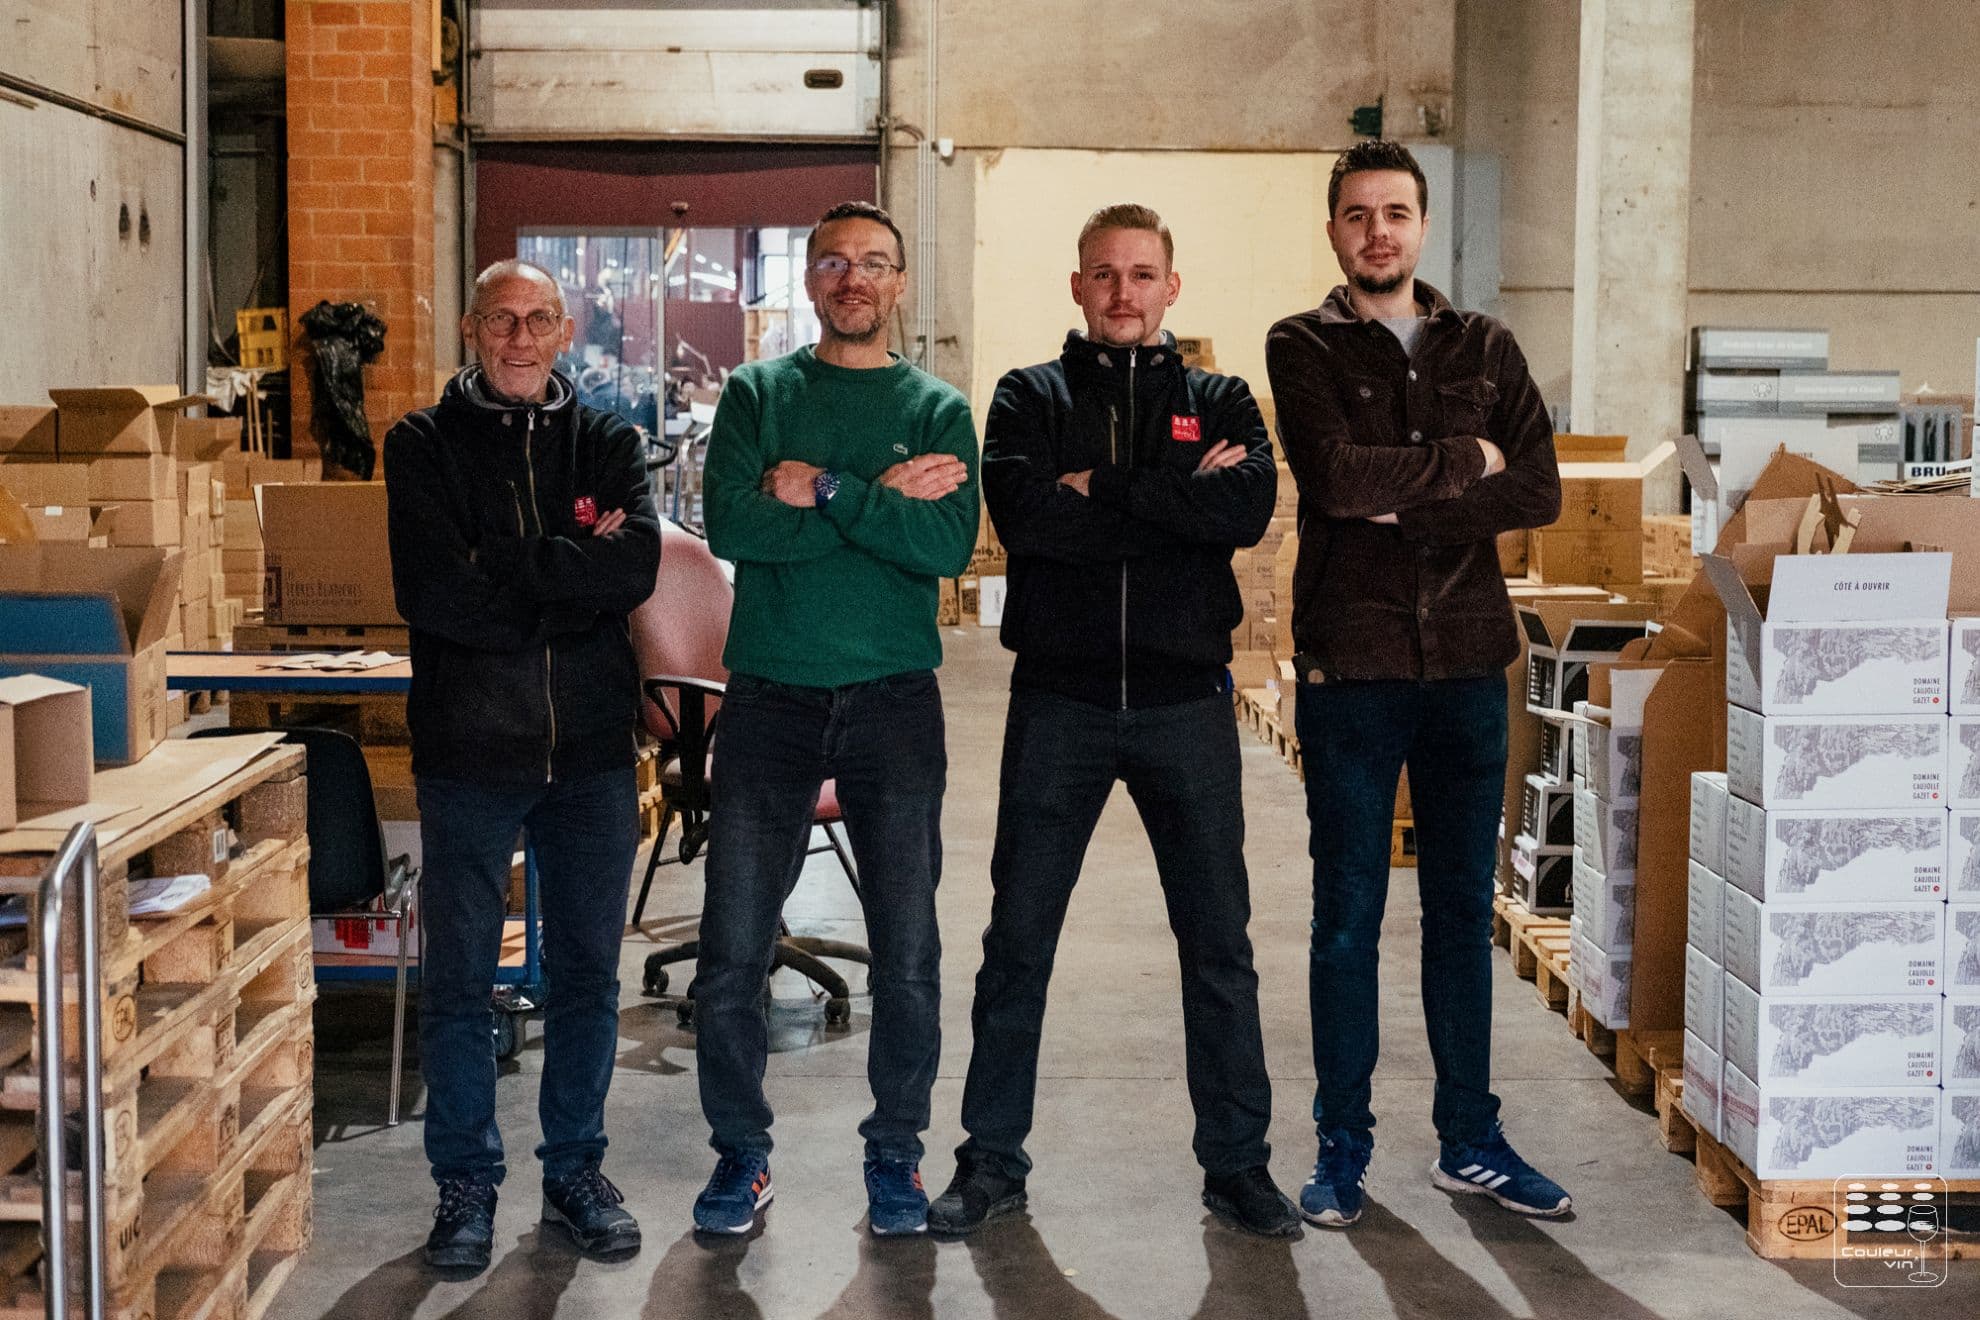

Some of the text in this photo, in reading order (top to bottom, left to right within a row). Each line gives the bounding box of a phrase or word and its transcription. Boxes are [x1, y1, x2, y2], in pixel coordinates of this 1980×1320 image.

[1833, 580, 1890, 591] CÔTÉ À OUVRIR
[1786, 1214, 1829, 1235] EPAL
